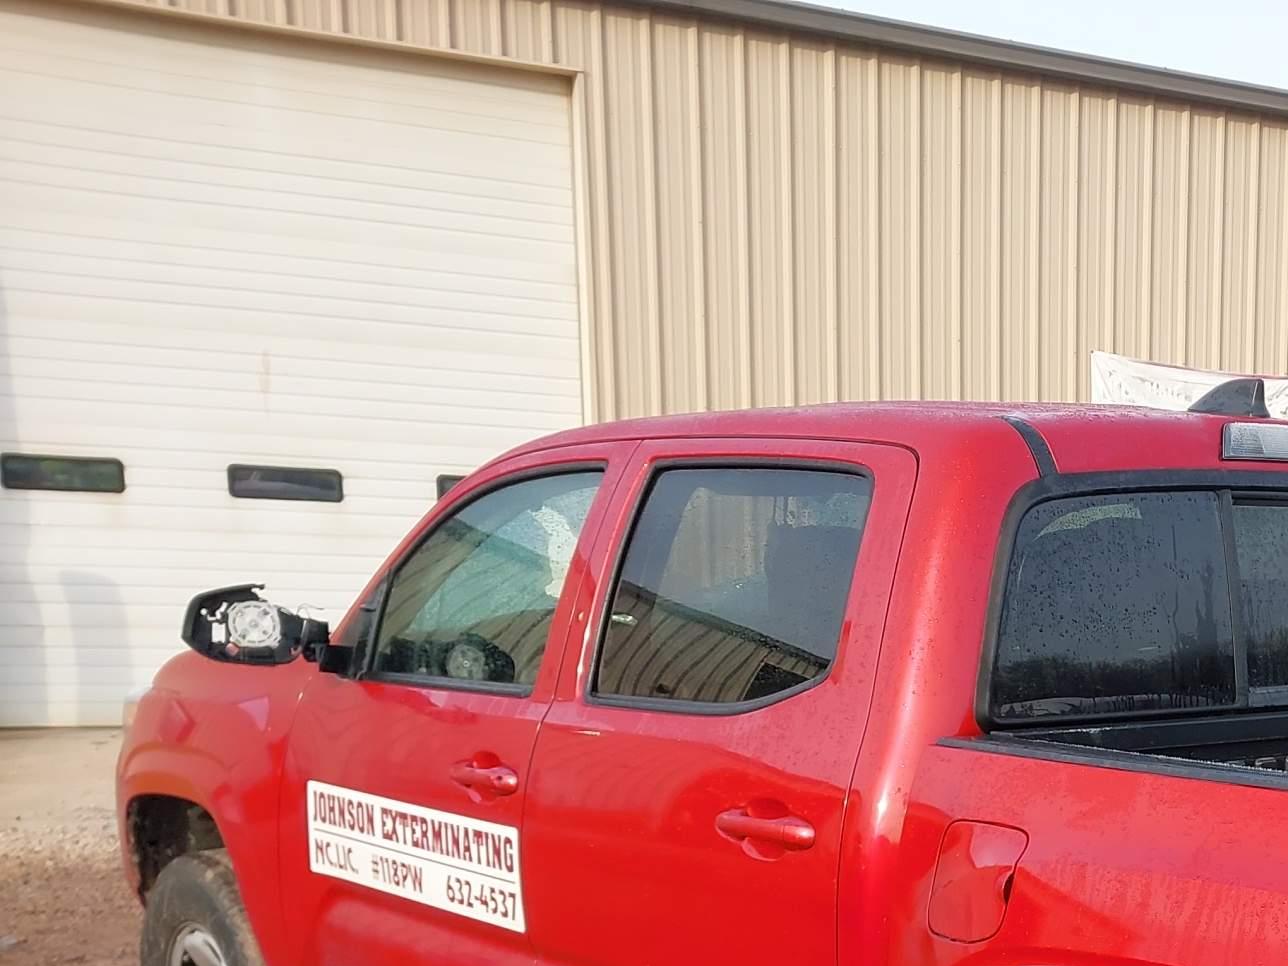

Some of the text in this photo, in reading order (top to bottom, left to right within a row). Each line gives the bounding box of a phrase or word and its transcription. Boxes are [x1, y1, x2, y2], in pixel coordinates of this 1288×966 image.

[313, 790, 515, 873] JOHNSON EXTERMINATING
[371, 855, 424, 894] #118PW
[446, 875, 517, 921] 632-4537
